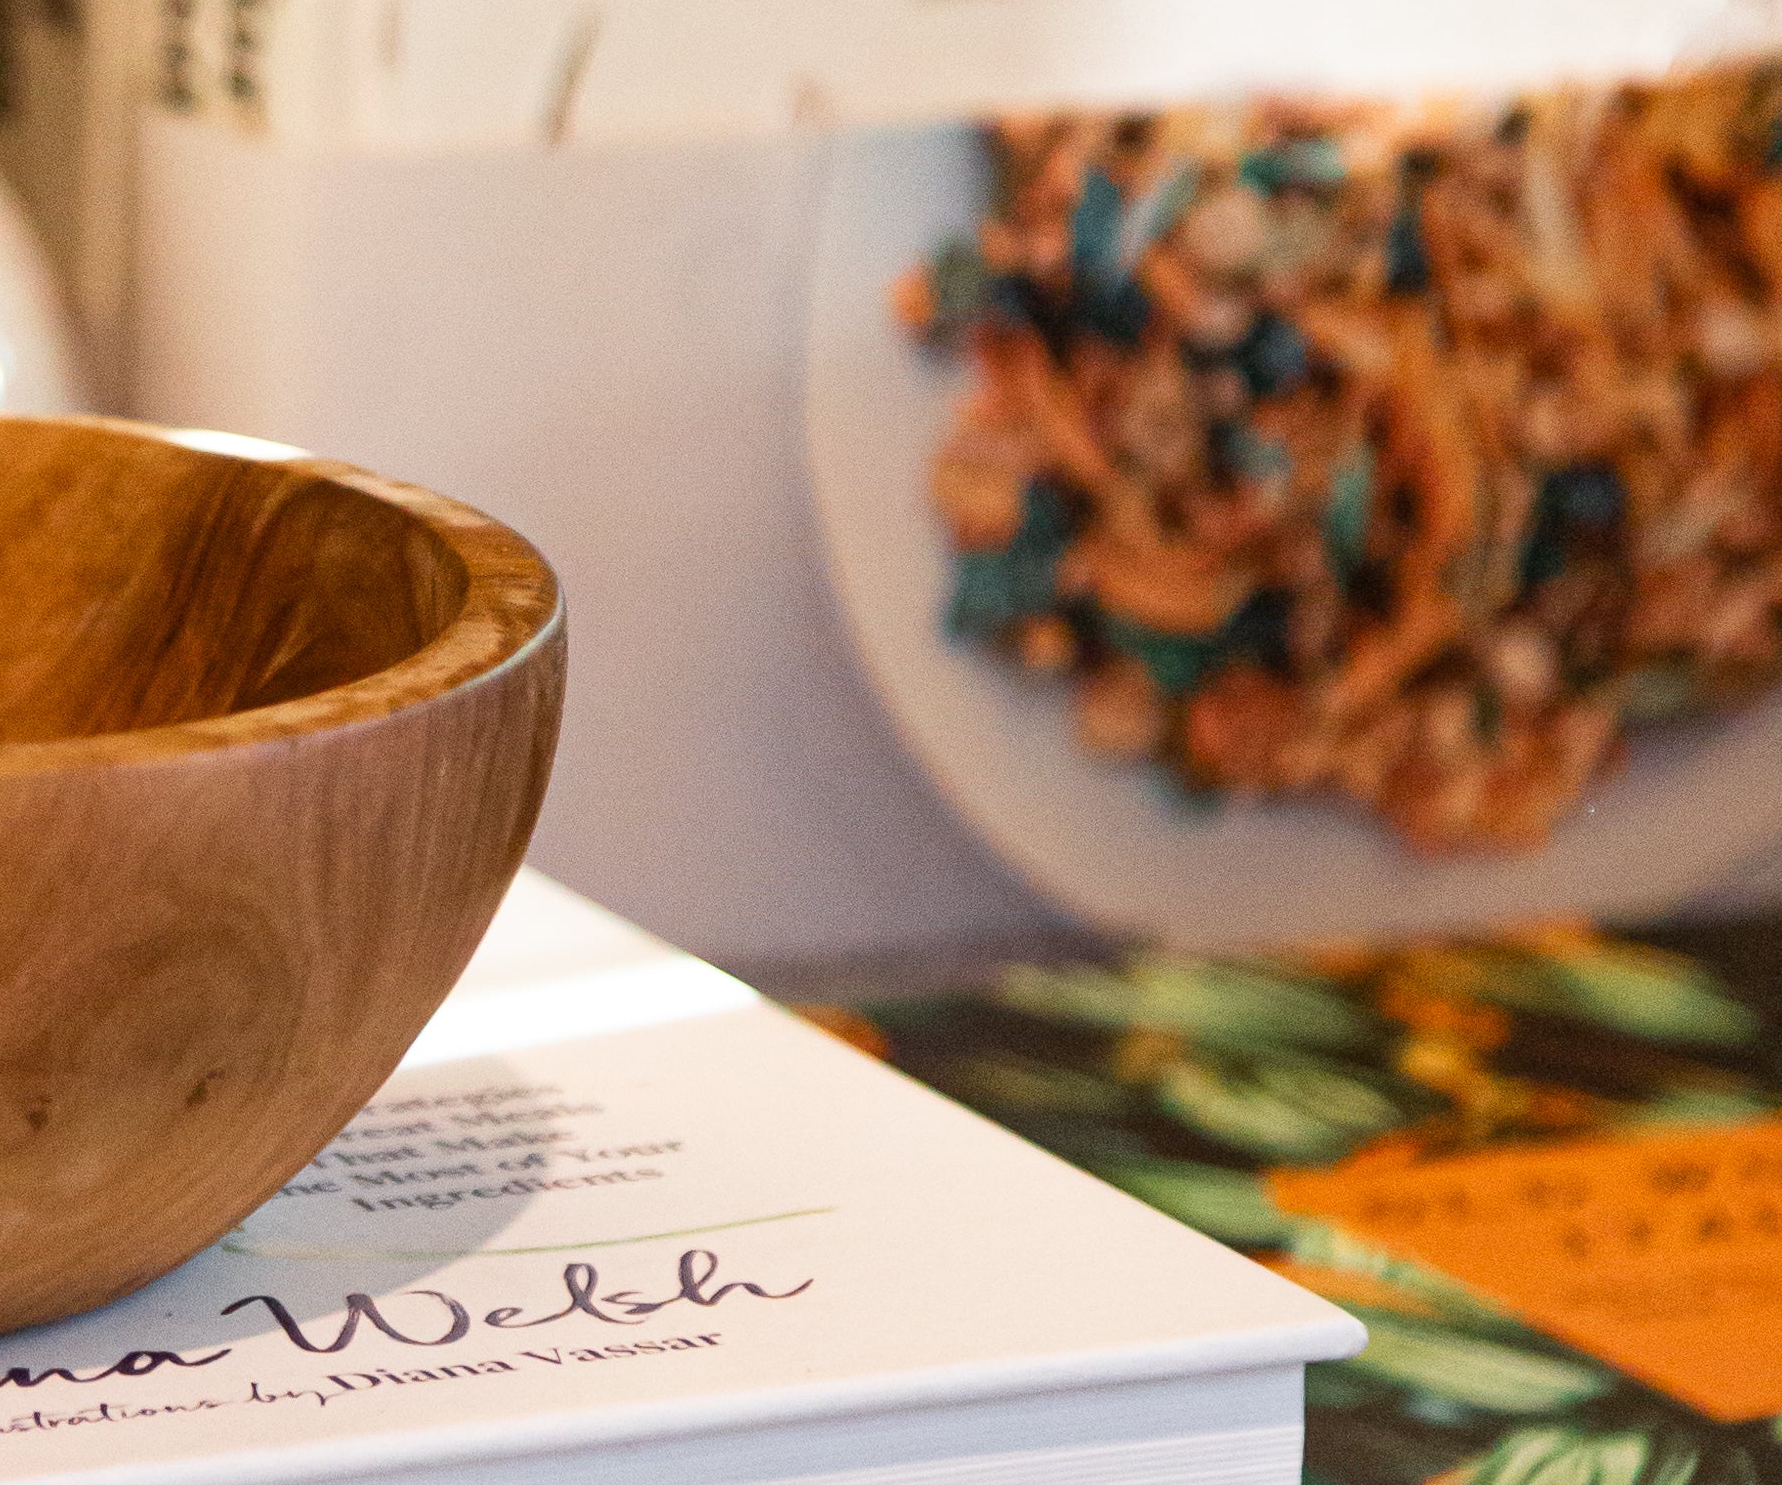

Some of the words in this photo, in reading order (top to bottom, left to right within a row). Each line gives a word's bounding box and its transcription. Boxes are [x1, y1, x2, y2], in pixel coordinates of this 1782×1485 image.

[352, 1163, 479, 1186] Most
[497, 1151, 551, 1171] of
[560, 1140, 684, 1163] Your
[352, 1167, 664, 1212] Ingredients
[221, 1249, 814, 1354] Welsh
[249, 1381, 336, 1407] by
[327, 1355, 516, 1391] Diana
[520, 1331, 724, 1367] Vassar
